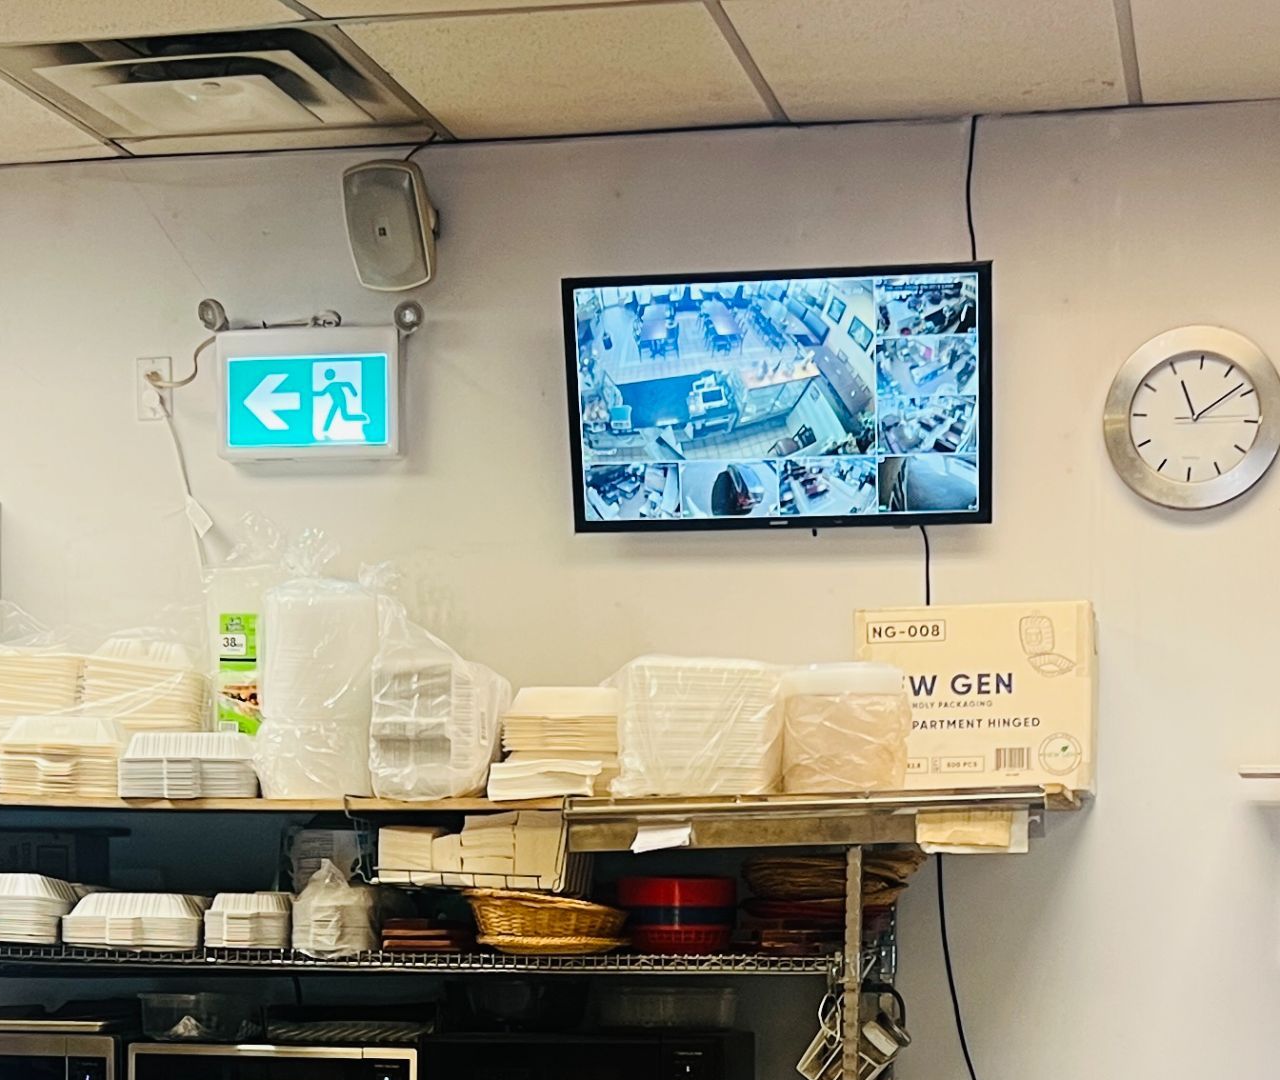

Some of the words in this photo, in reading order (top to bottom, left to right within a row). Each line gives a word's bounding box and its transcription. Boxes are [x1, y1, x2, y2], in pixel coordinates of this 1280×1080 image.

[871, 624, 941, 639] NG-008
[950, 672, 1014, 696] GEN
[937, 699, 993, 708] PACKAGING
[987, 716, 1041, 729] HINGED
